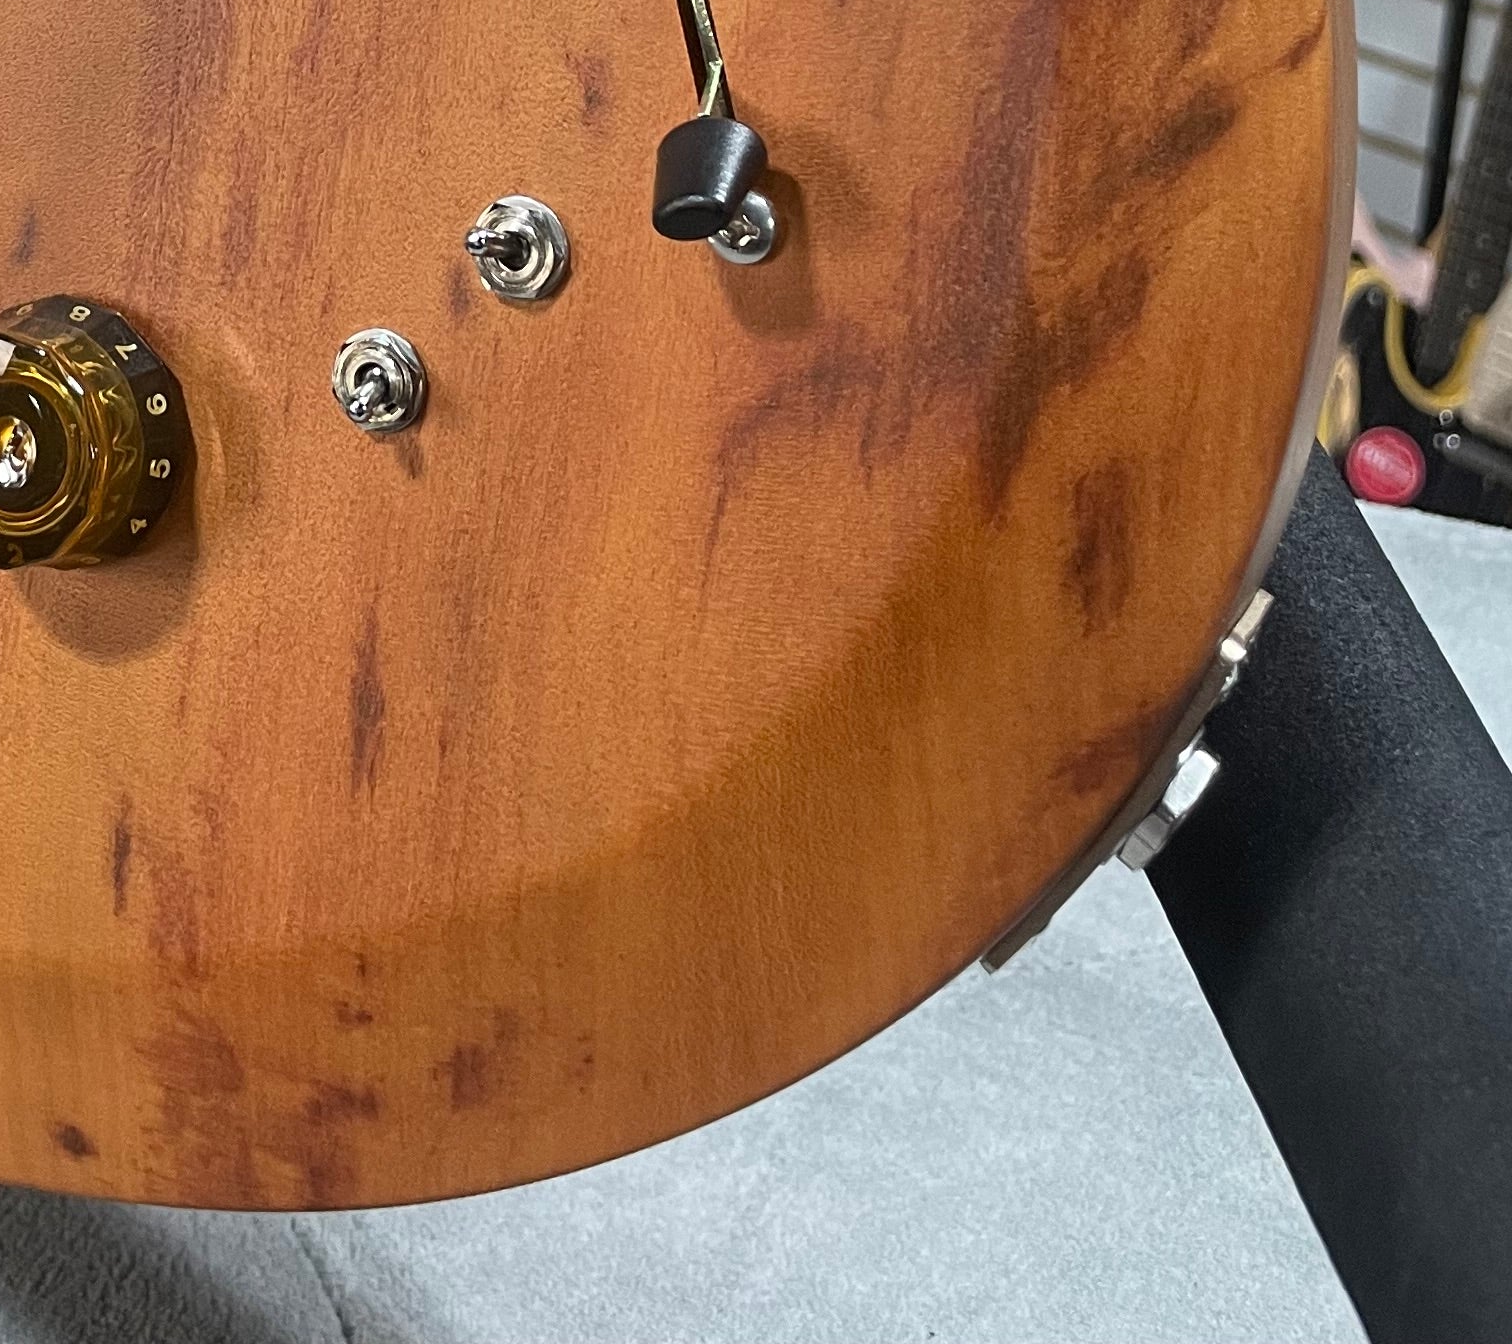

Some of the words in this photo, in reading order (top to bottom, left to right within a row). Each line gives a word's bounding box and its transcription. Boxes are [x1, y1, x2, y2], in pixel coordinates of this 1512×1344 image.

[69, 305, 91, 322] 8
[114, 343, 138, 360] 7
[145, 393, 168, 415] 6
[149, 458, 171, 479] 5
[131, 517, 147, 534] 4
